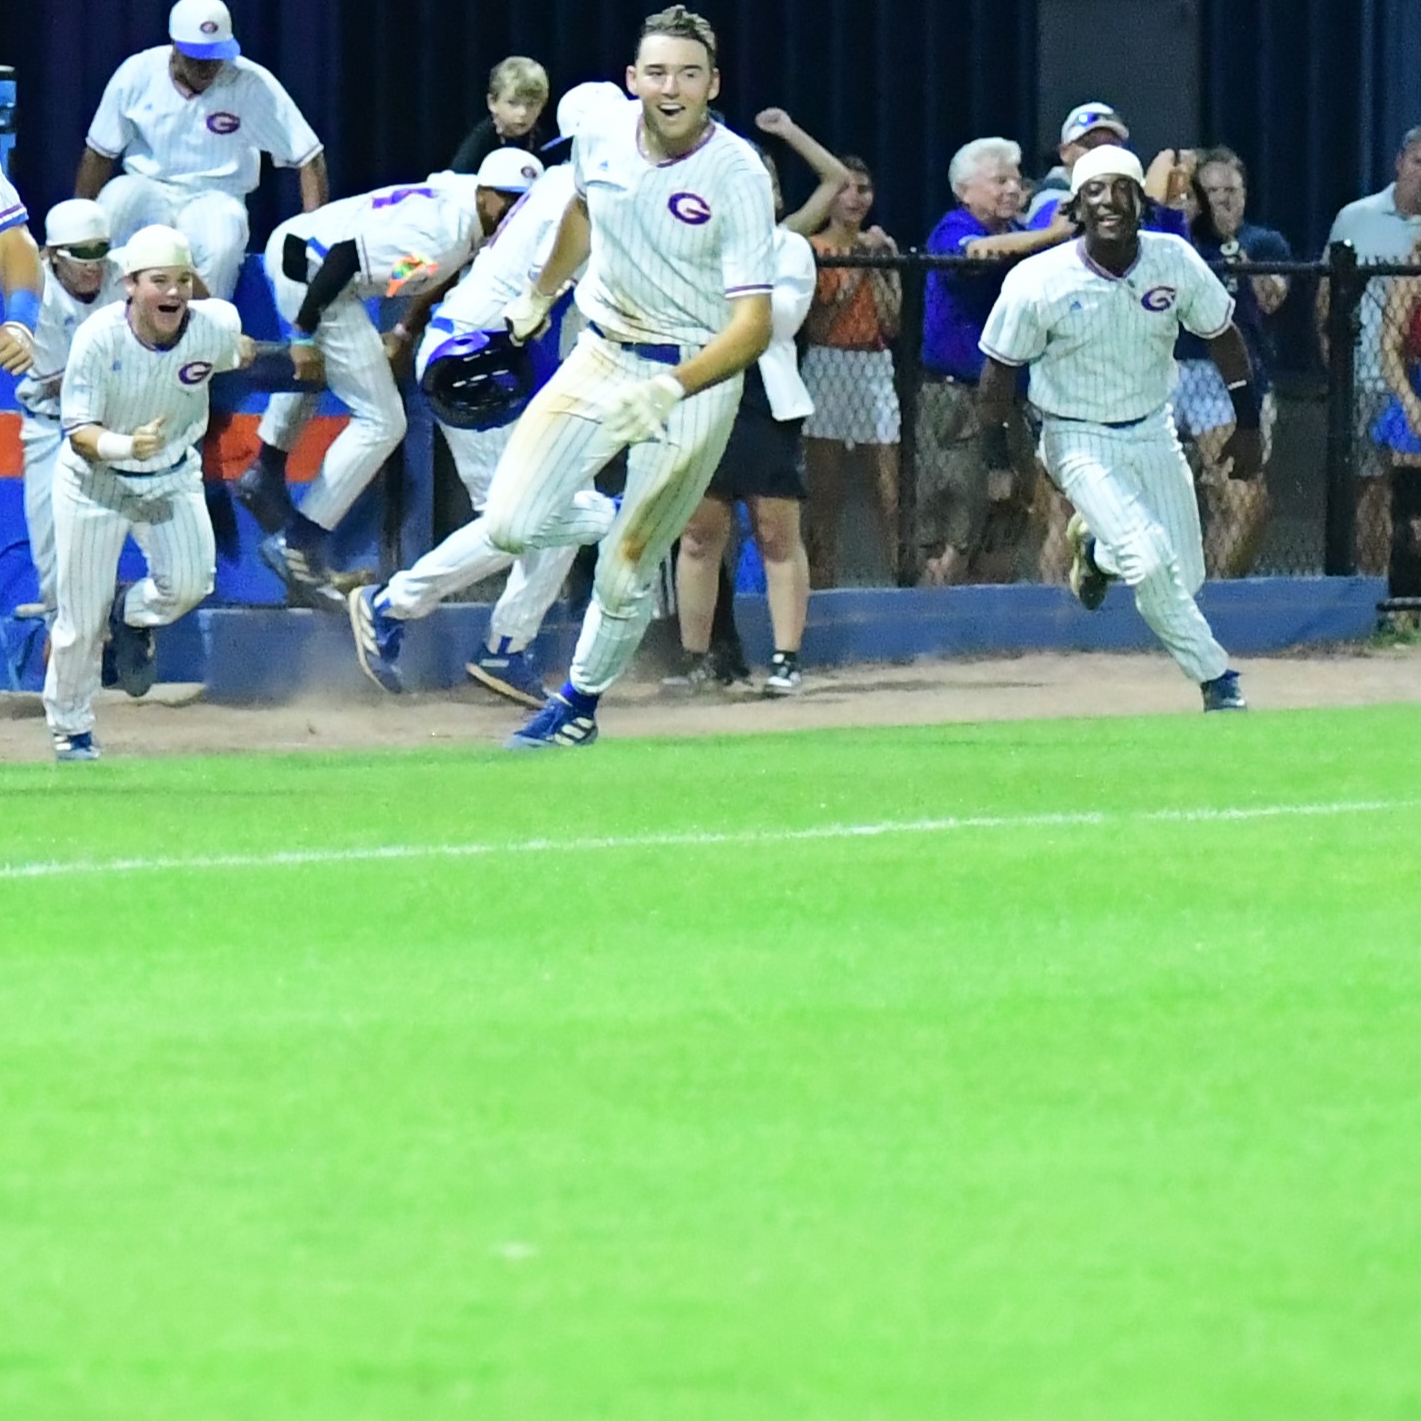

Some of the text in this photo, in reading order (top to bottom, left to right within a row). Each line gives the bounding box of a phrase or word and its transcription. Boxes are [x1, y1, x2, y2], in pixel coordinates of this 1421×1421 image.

[206, 112, 241, 134] G
[667, 192, 711, 225] G
[1140, 285, 1175, 312] G
[178, 361, 213, 384] G
